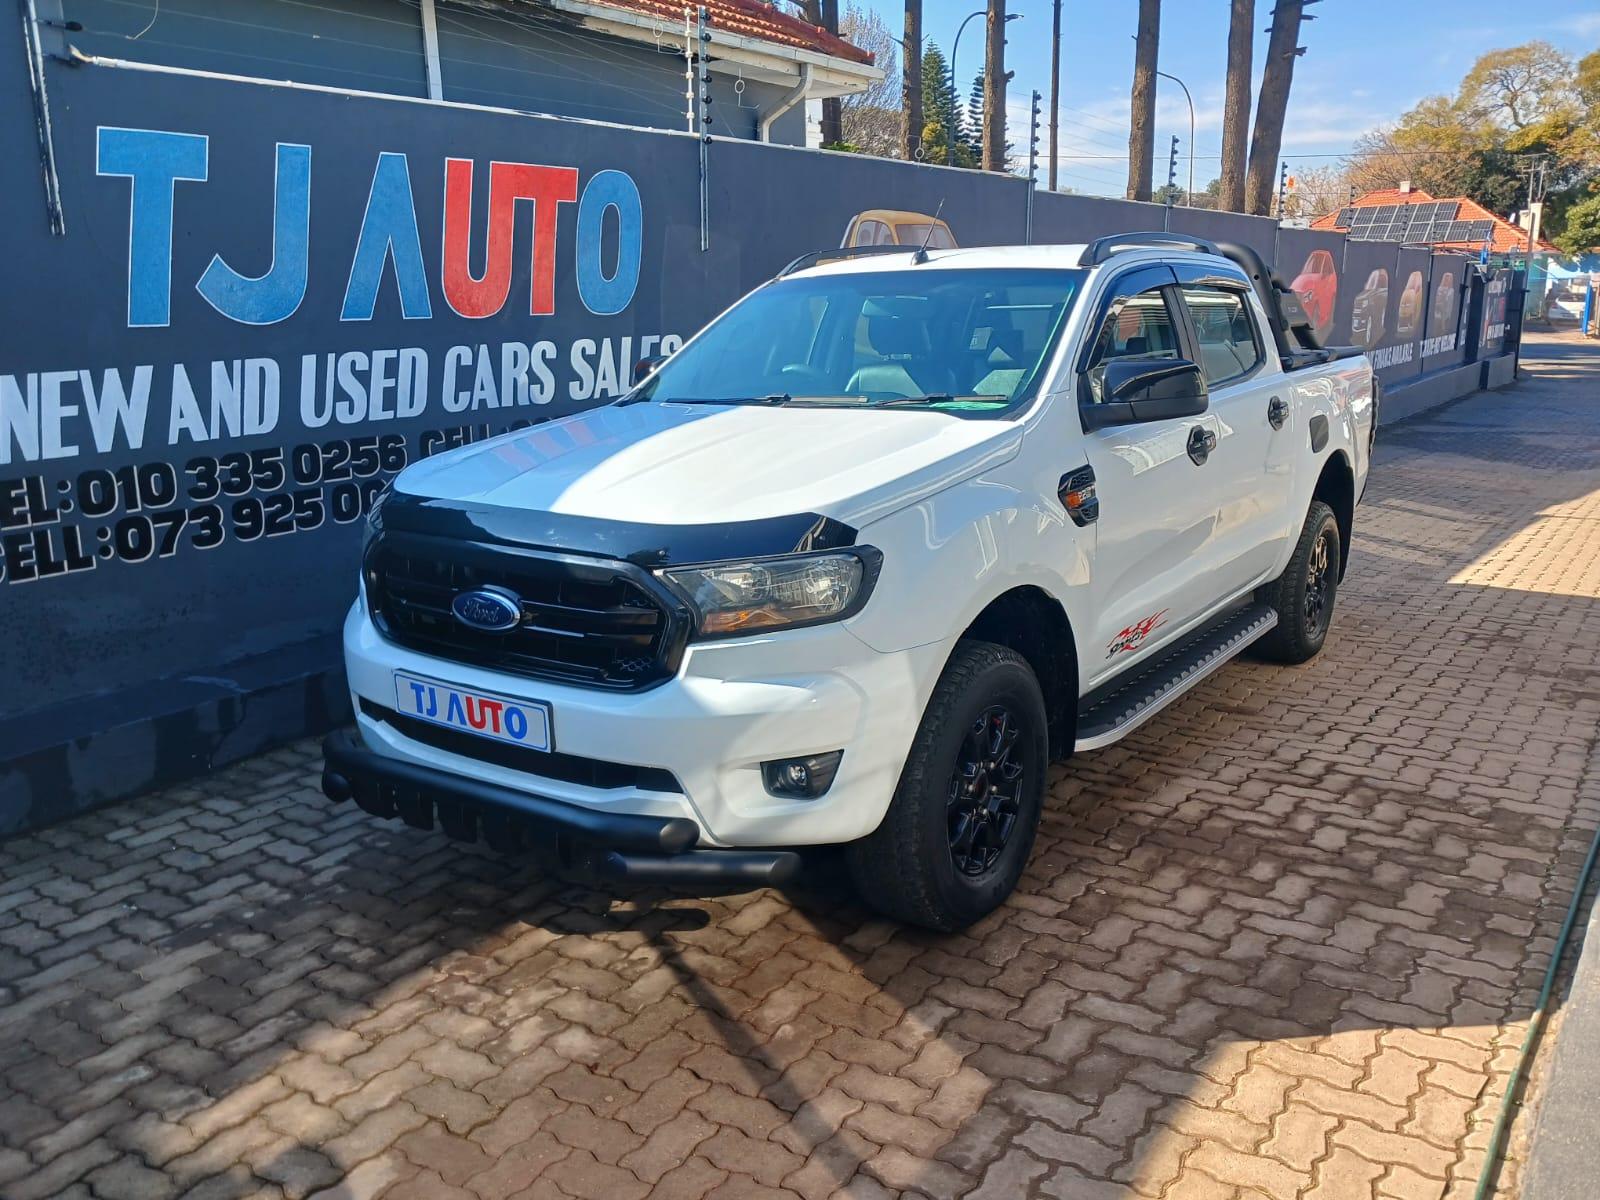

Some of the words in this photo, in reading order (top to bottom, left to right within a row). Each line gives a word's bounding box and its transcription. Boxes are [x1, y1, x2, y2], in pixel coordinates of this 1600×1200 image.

[96, 126, 312, 327] TJ
[340, 152, 642, 322] AUTO
[0, 365, 153, 465] NEW
[168, 357, 281, 445] AND
[300, 346, 429, 429] USED
[442, 341, 557, 413] CARS
[569, 334, 683, 401] SAL
[185, 447, 286, 502] 335
[292, 434, 408, 486] 0256
[231, 487, 326, 542] 925
[463, 597, 501, 623] Ford
[410, 682, 438, 718] TJ
[447, 692, 528, 740] AUTO
